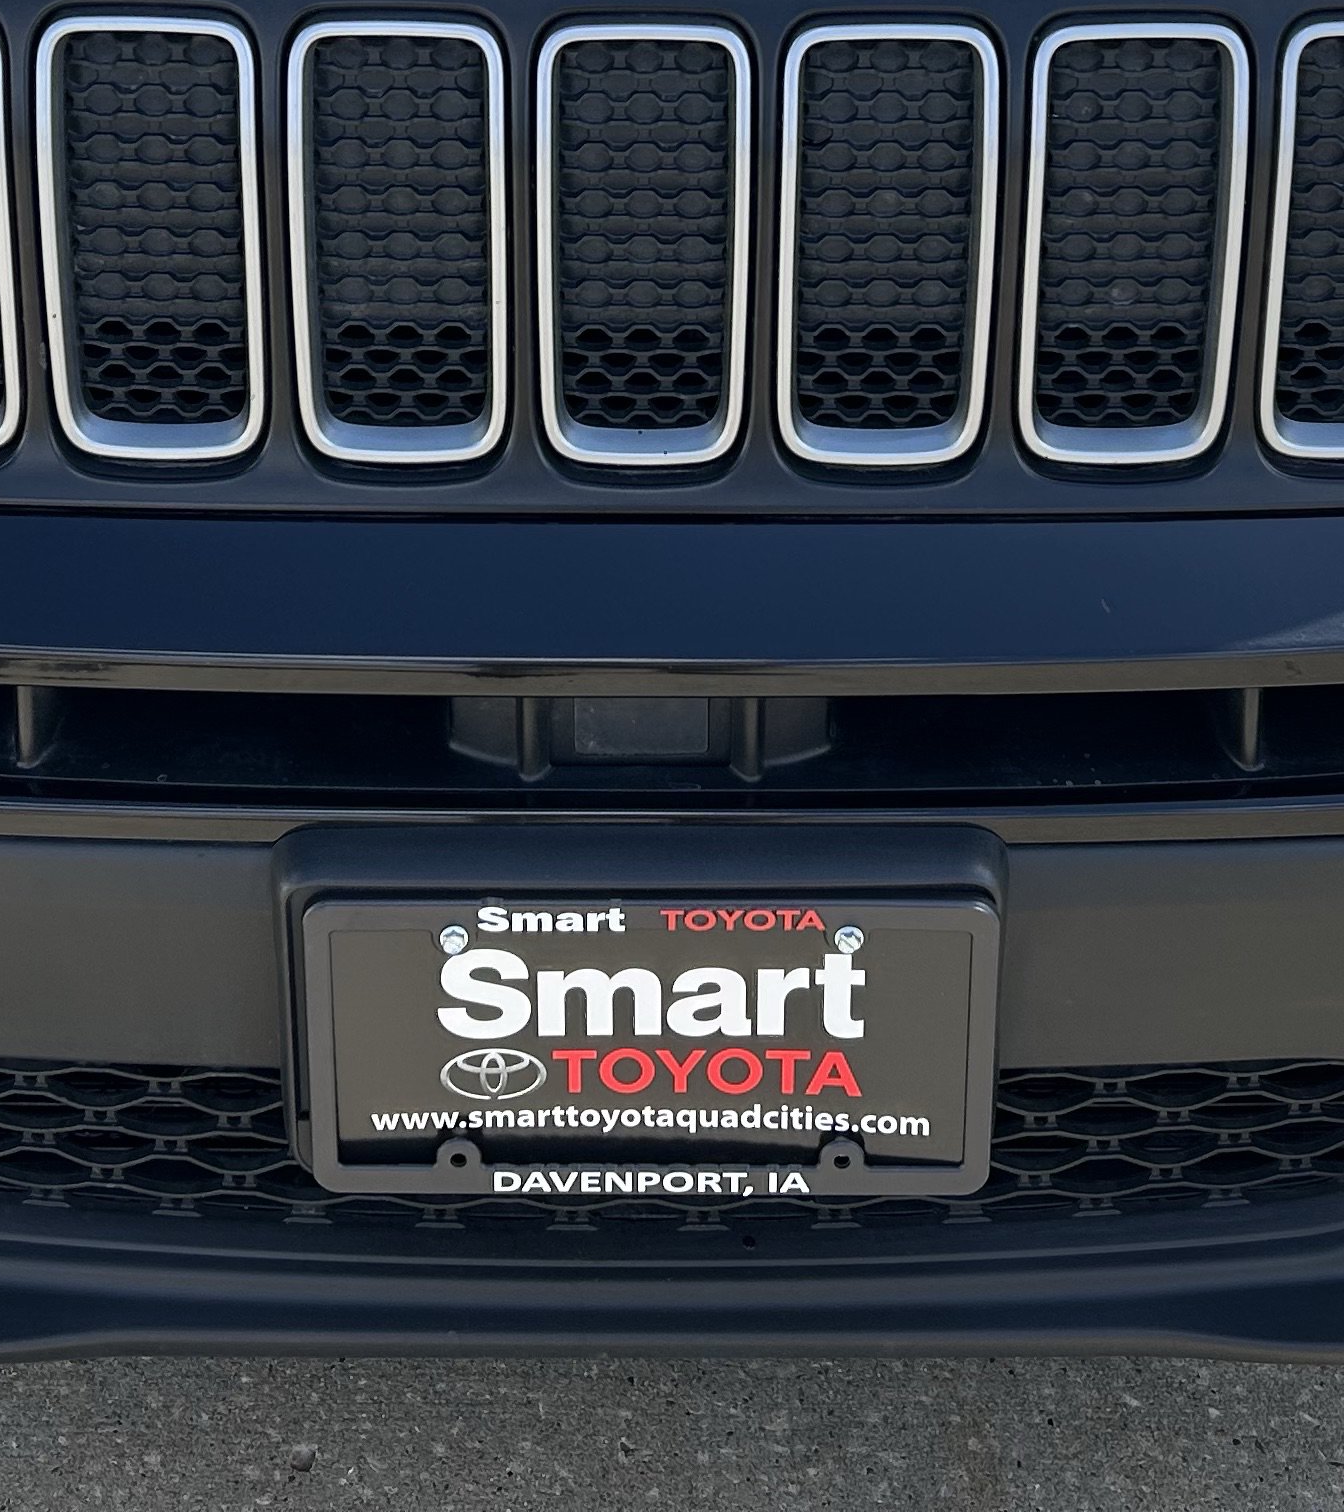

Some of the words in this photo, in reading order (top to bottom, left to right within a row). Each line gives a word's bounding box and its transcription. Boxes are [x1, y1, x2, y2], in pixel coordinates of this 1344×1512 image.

[478, 906, 626, 932] Smart
[660, 909, 825, 932] TOYOTA
[437, 948, 866, 1040] Smart
[551, 1048, 862, 1097] TOYOTA
[371, 1104, 931, 1137] www.smarttoyotaquadcities.com
[493, 1170, 754, 1196] DAVENPORT,
[768, 1171, 811, 1193] IA
